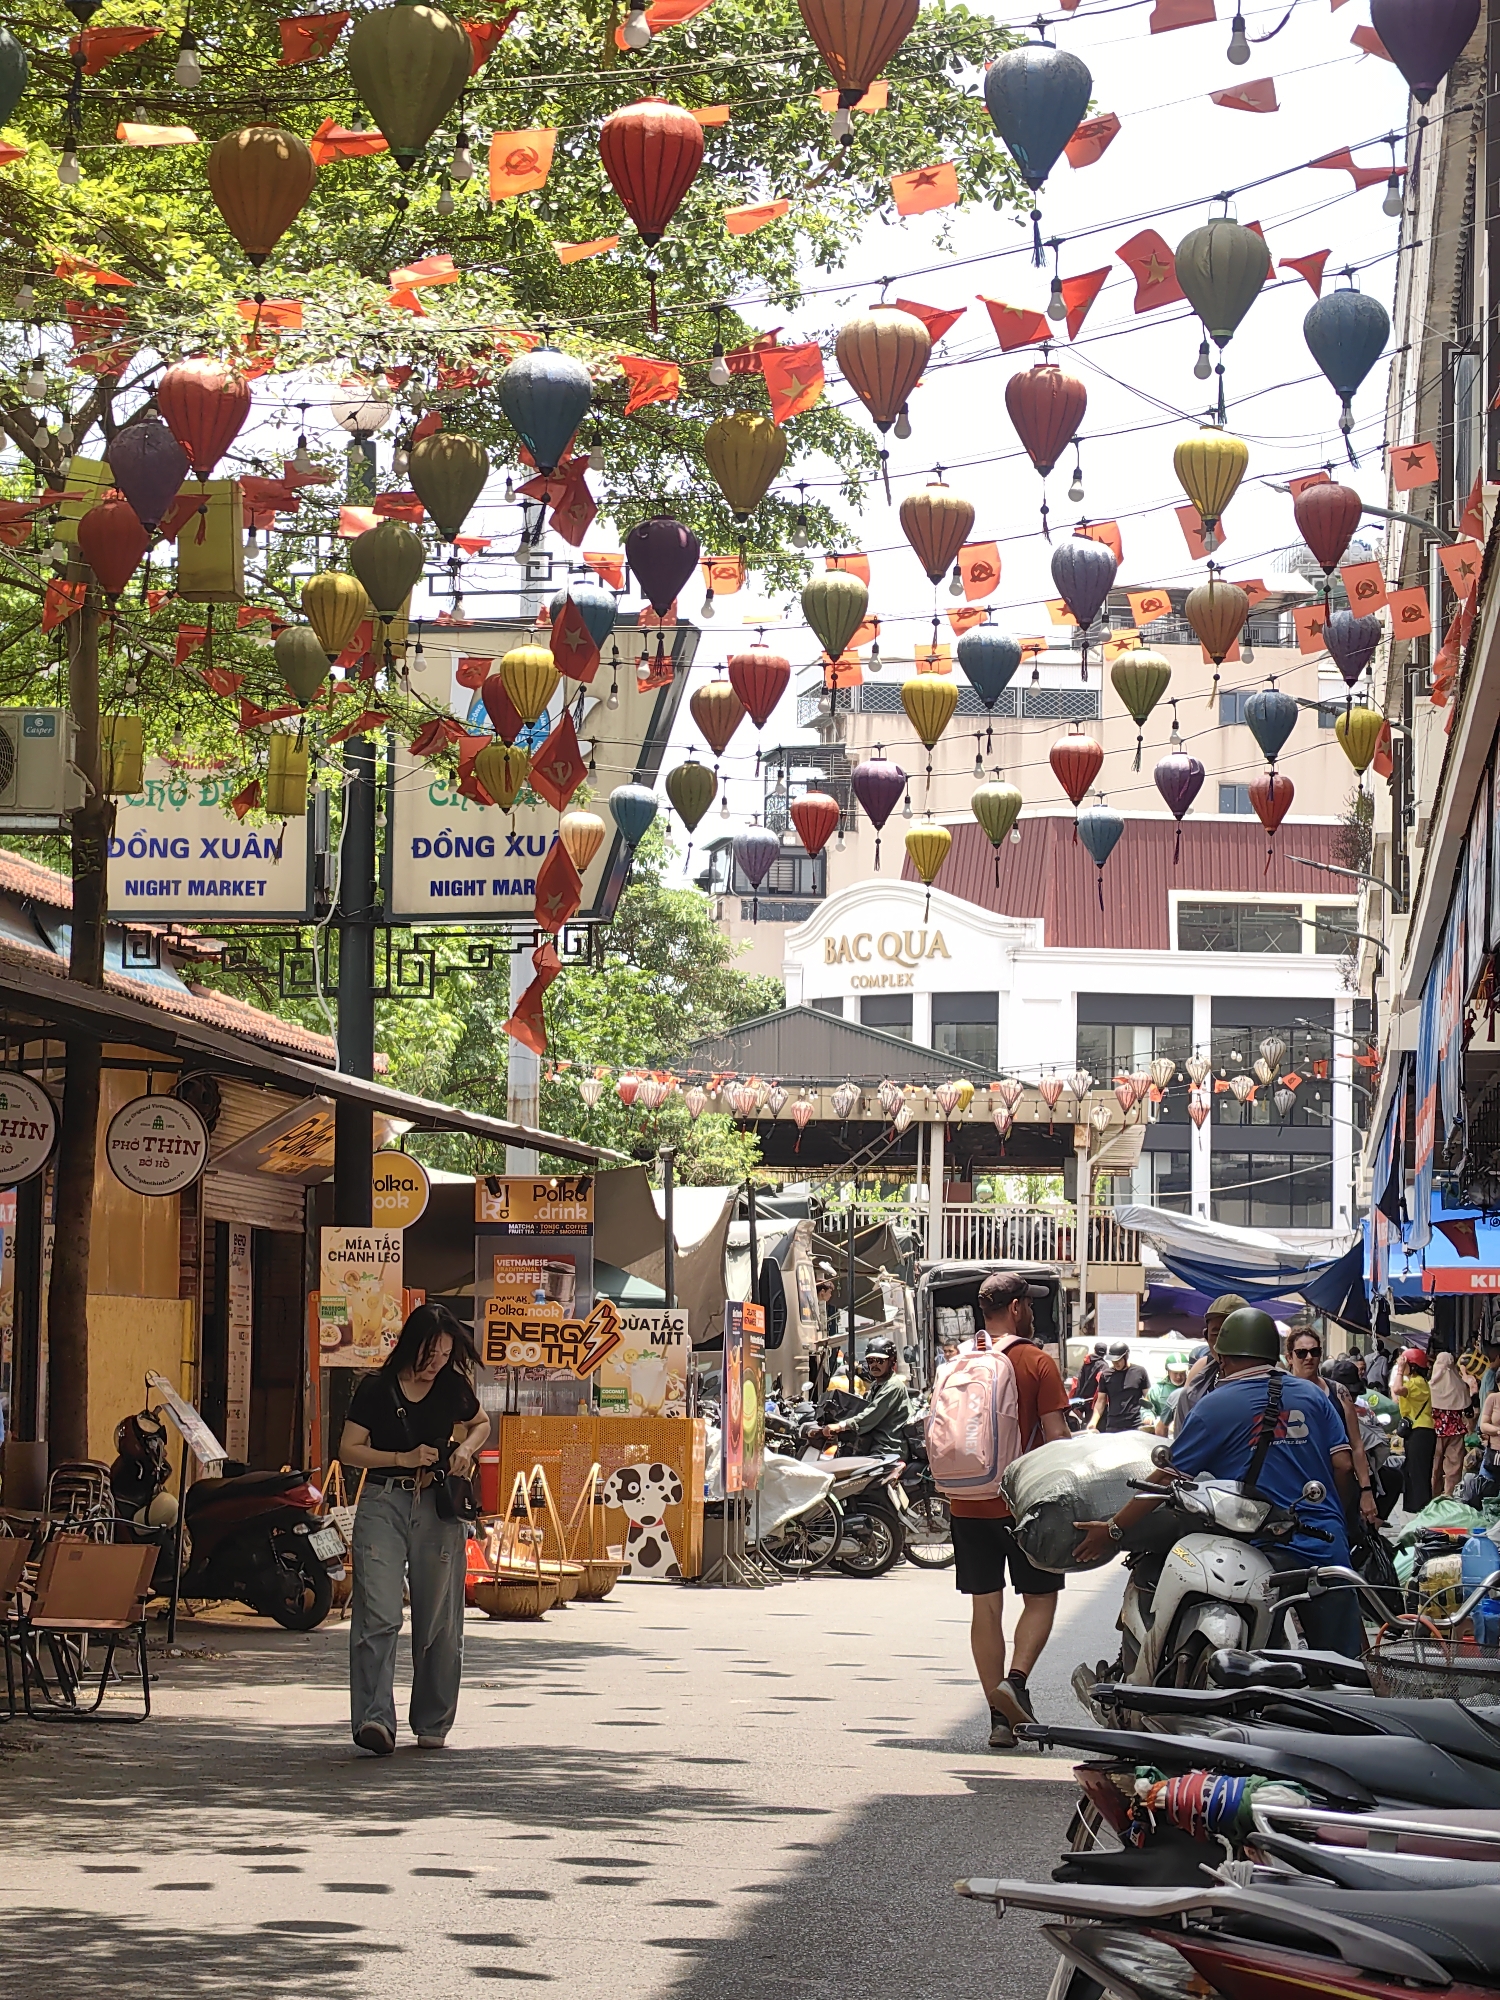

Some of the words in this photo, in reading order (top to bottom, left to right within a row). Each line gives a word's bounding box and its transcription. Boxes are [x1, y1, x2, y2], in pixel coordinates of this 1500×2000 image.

[26, 726, 52, 735] Casper
[107, 828, 190, 859] ĐỒNG
[199, 832, 283, 859] XUÂN
[411, 828, 495, 858] ĐỒNG
[125, 880, 181, 896] NIGHT
[188, 880, 267, 896] MARKET
[430, 880, 487, 897] NIGHT
[492, 878, 537, 895] MAR
[823, 932, 873, 964] BAC
[877, 929, 952, 968] QUA
[850, 973, 914, 989] COMPLEX
[0, 1116, 49, 1141] HÌN
[143, 1135, 201, 1156] THÌN
[373, 1174, 419, 1192] olka.
[533, 1184, 587, 1202] Polka
[533, 1203, 588, 1220] .drink
[345, 1235, 372, 1250] MÍA
[375, 1233, 400, 1251] TẮC
[328, 1251, 375, 1262] CHANH
[497, 1259, 548, 1267] VIETNAMESE
[496, 1272, 549, 1284] COFFEE
[488, 1320, 593, 1344] ENERGY
[650, 1326, 684, 1345] MÍT
[486, 1341, 578, 1365] BOOTH
[965, 1416, 979, 1456] YONEX
